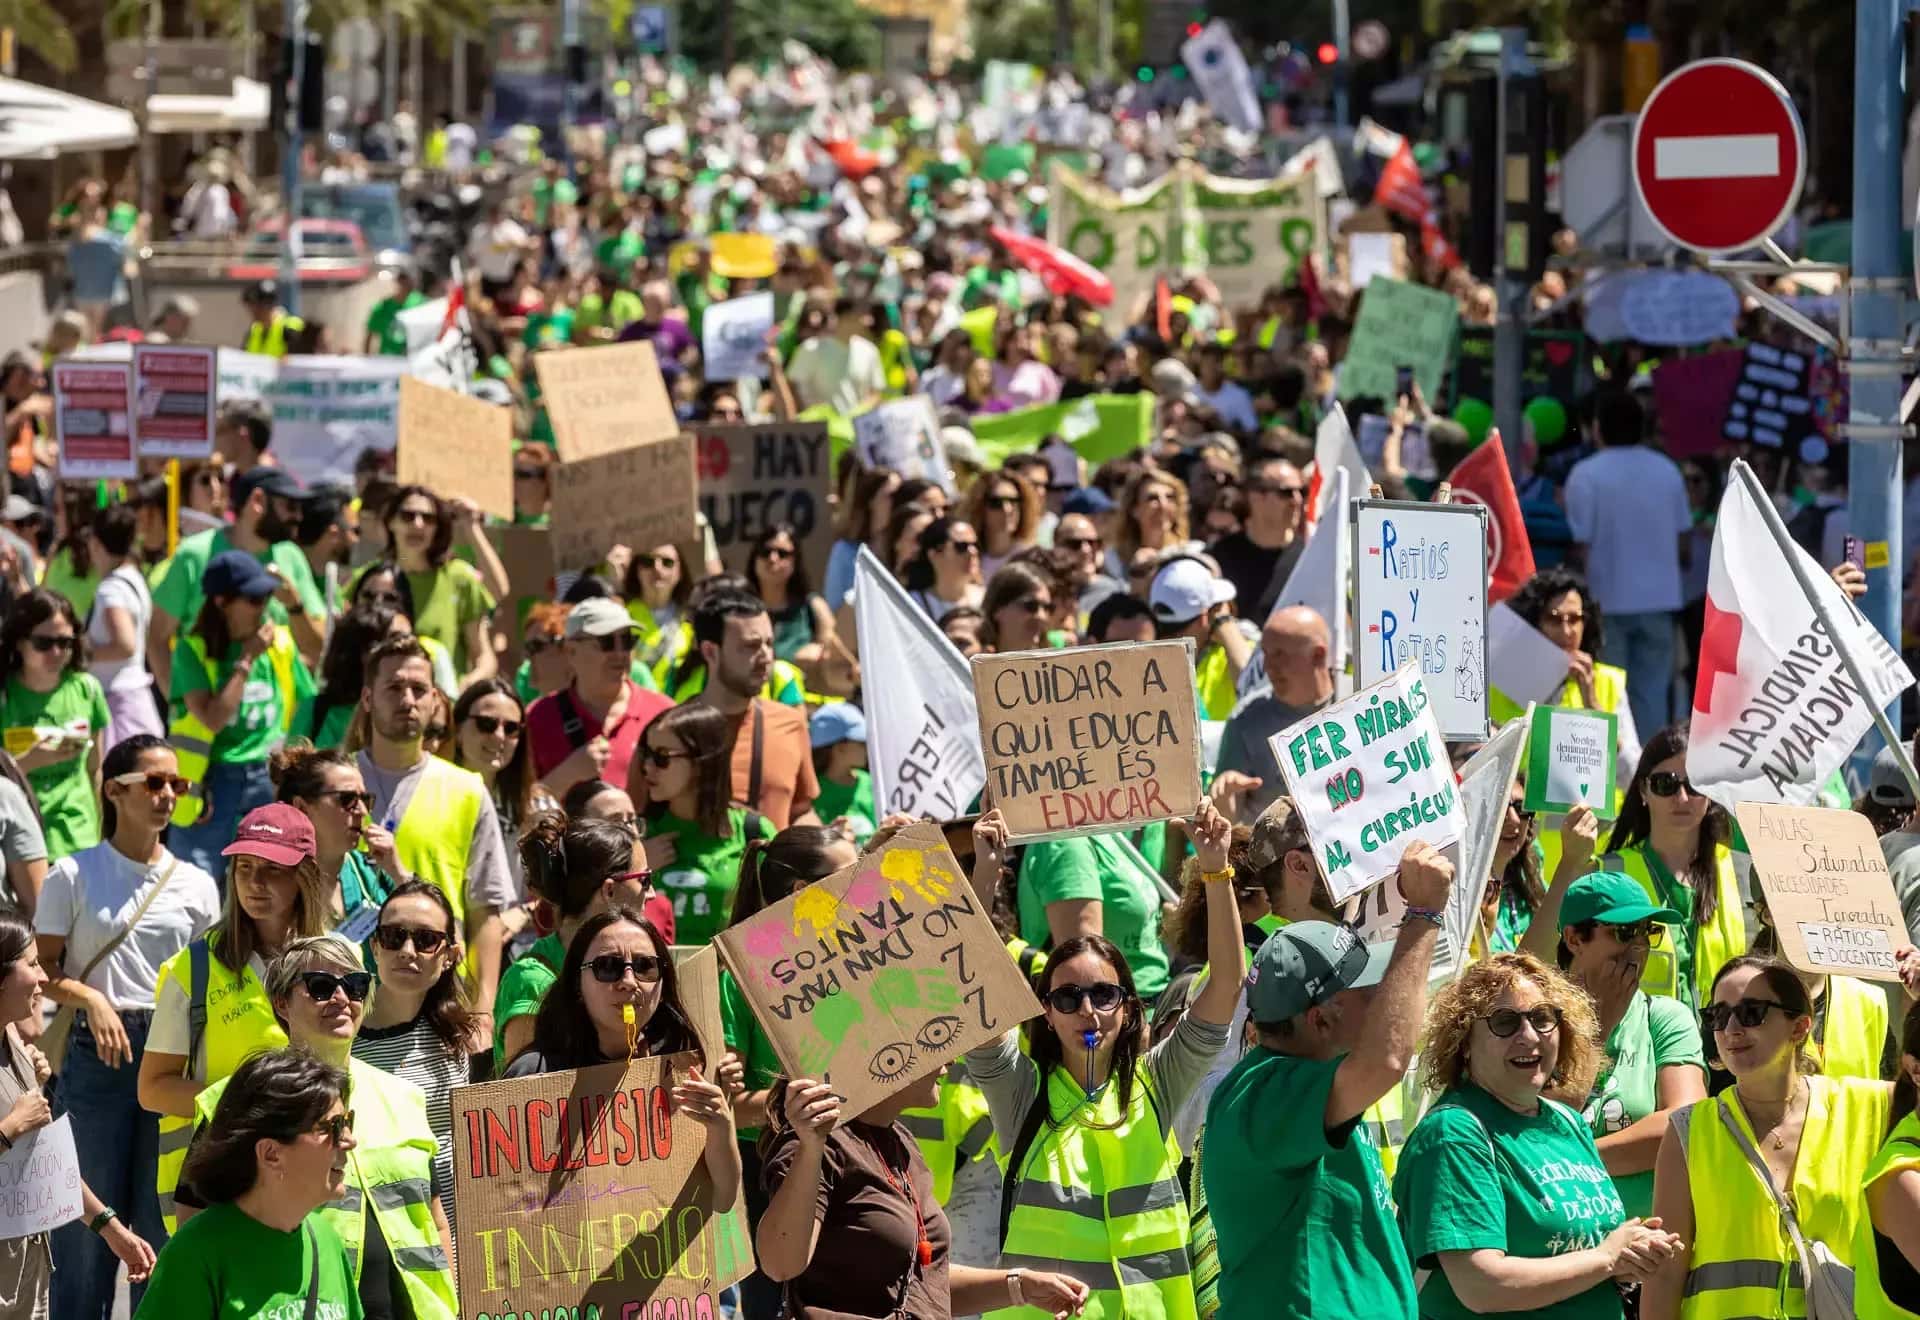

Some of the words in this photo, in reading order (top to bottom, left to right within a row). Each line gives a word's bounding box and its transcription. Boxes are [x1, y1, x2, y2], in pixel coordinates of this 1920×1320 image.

[753, 430, 827, 480] HAY
[1143, 658, 1168, 695] A
[1068, 710, 1179, 750] EDUCA
[1287, 721, 1352, 777] FER
[991, 752, 1097, 798] TAMBÉ
[1117, 744, 1156, 782] ÉS
[1327, 768, 1363, 812] NO
[1040, 778, 1172, 830] EDUCAR
[1760, 807, 1815, 842] AULAS
[1325, 840, 1352, 875] AL
[1803, 843, 1889, 875] Saturadas
[1767, 872, 1850, 897] NECESIDADES
[923, 895, 976, 938] NO
[844, 927, 915, 981] DAN
[1828, 948, 1895, 969] DOCENTES
[769, 968, 841, 1020] PARA
